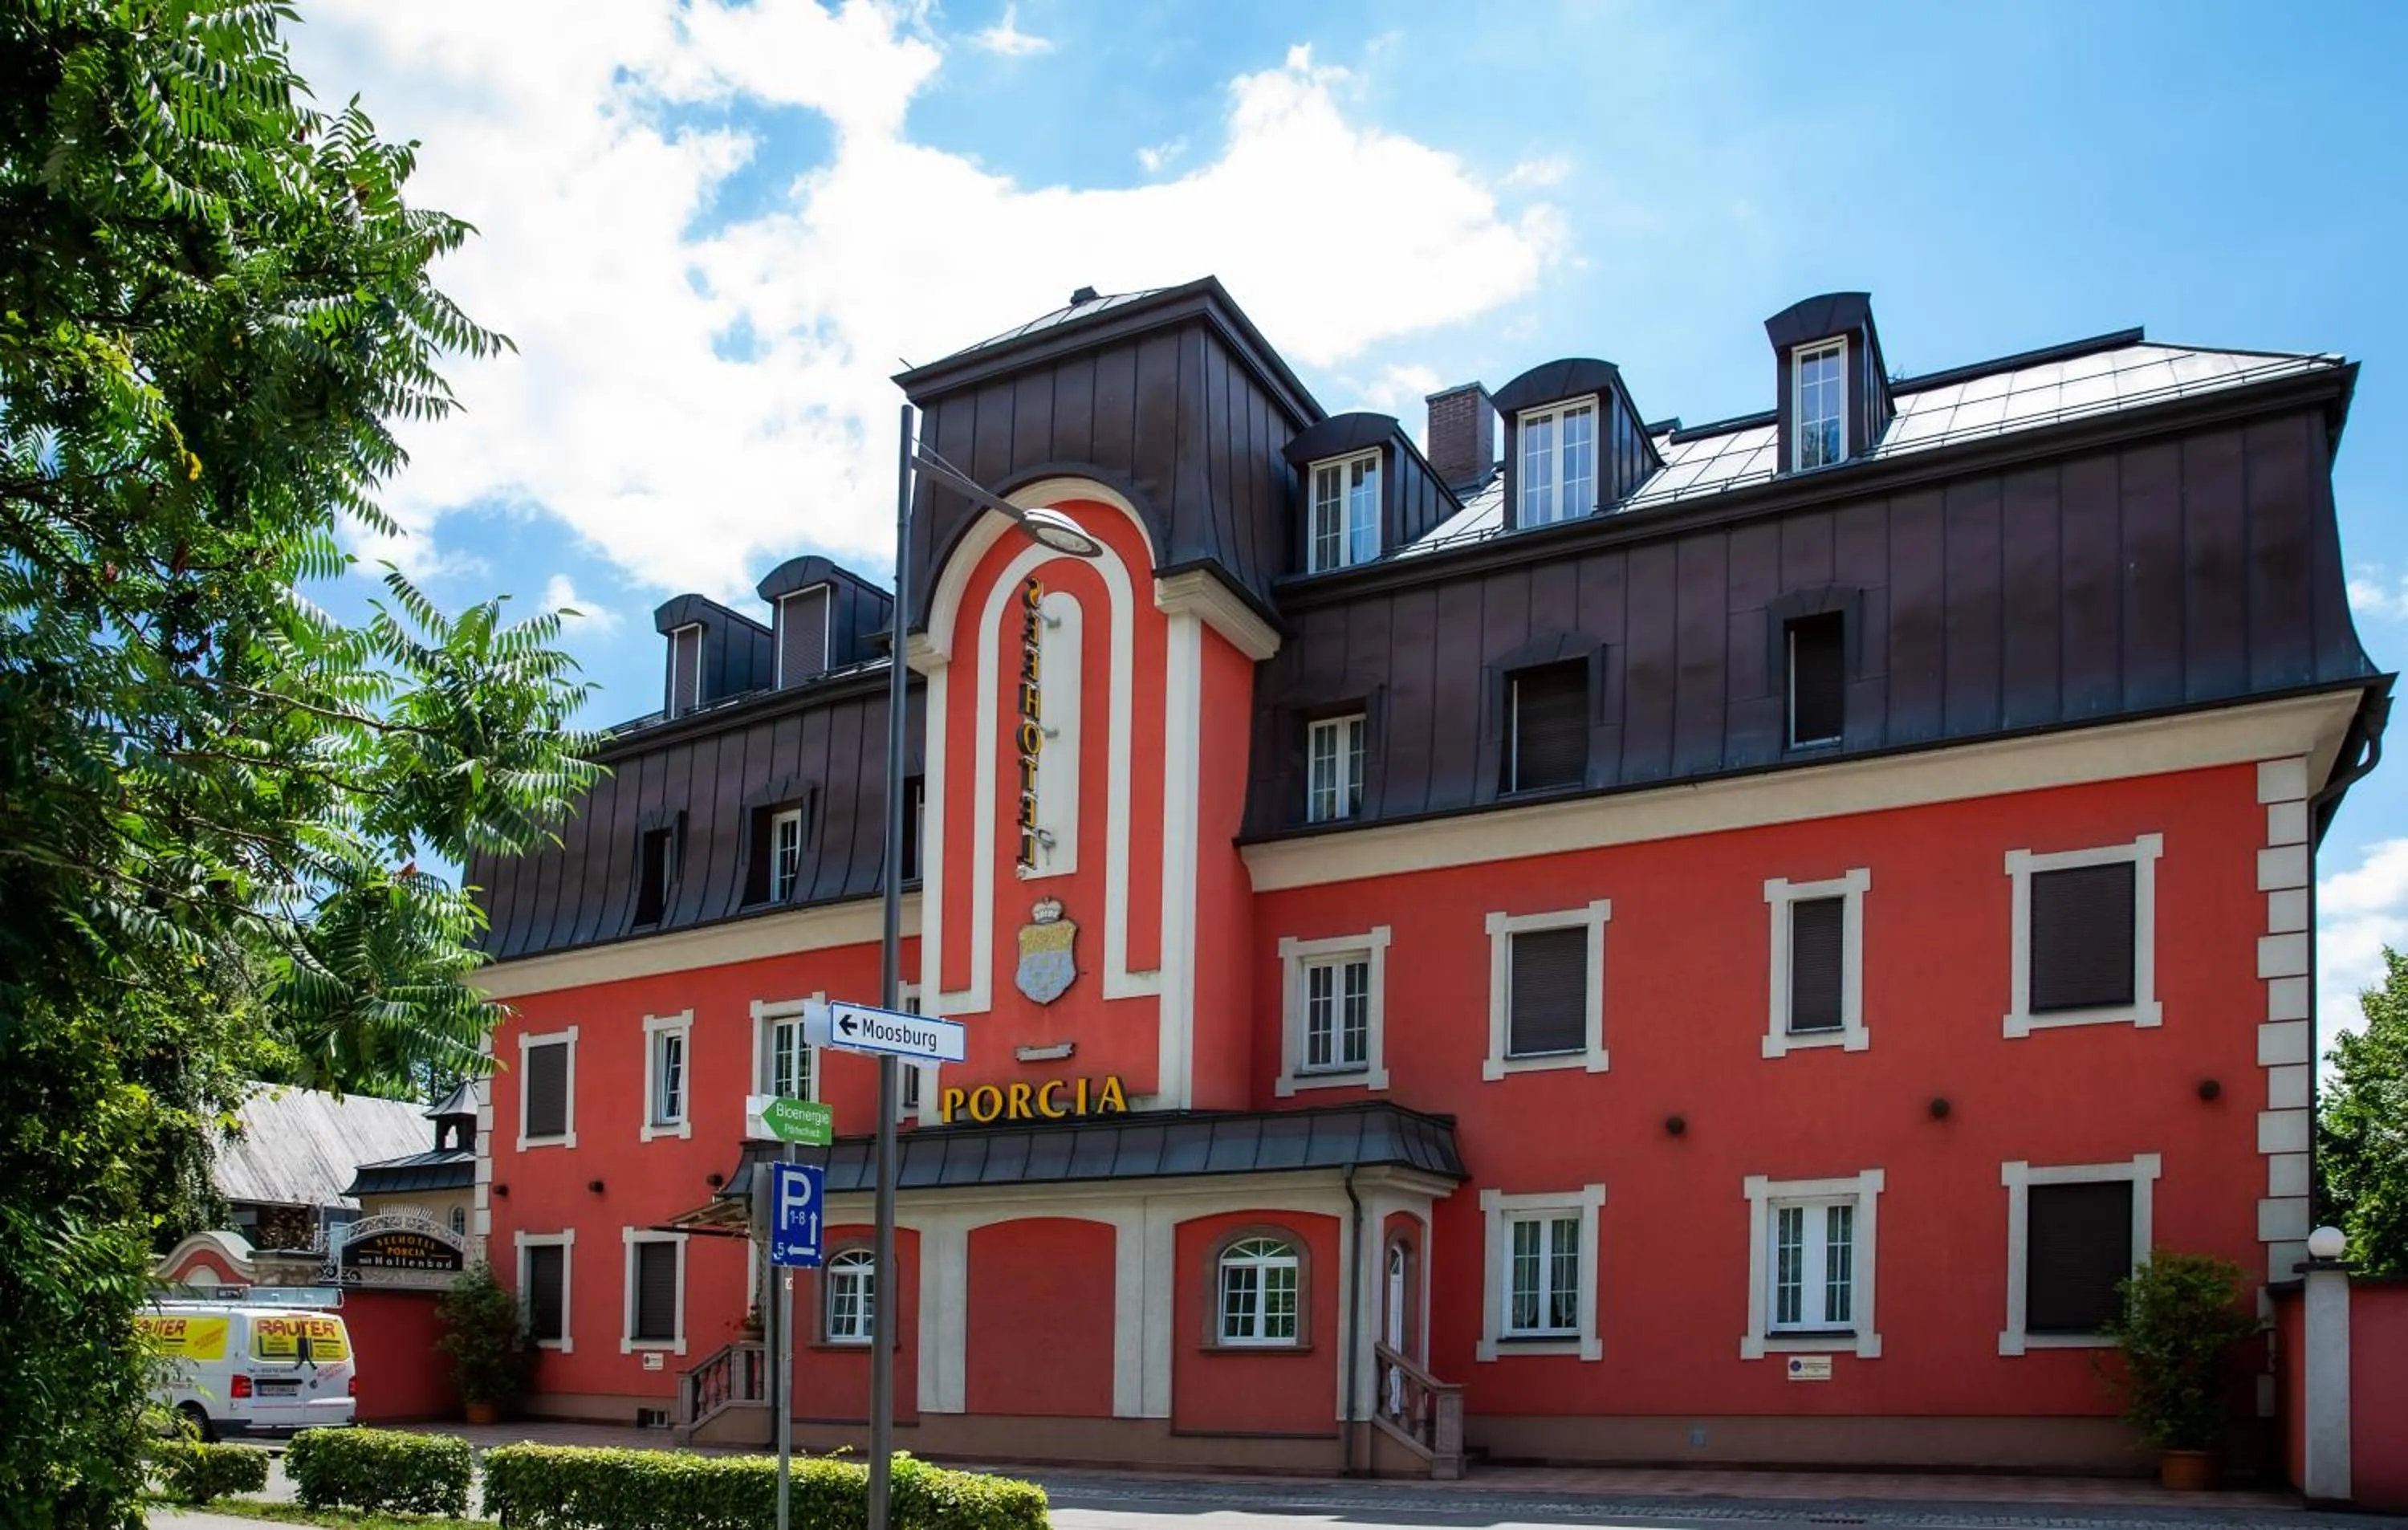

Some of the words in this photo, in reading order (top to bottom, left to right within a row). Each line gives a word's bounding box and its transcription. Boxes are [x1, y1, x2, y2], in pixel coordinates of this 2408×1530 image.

[1016, 576, 1042, 870] SEEHOTEL
[862, 1017, 938, 1052] Moosburg
[942, 1076, 1129, 1124] PORCIA
[775, 1102, 830, 1126] Bioenergie
[781, 1170, 812, 1231] P
[789, 1210, 807, 1226] 1-8
[376, 1235, 436, 1251] SEEHOTEL
[386, 1247, 426, 1257] PORCIA
[776, 1242, 784, 1256] 5
[375, 1255, 453, 1269] Hallenbad
[136, 1319, 188, 1337] AUTER
[257, 1319, 336, 1338] RAUTER
